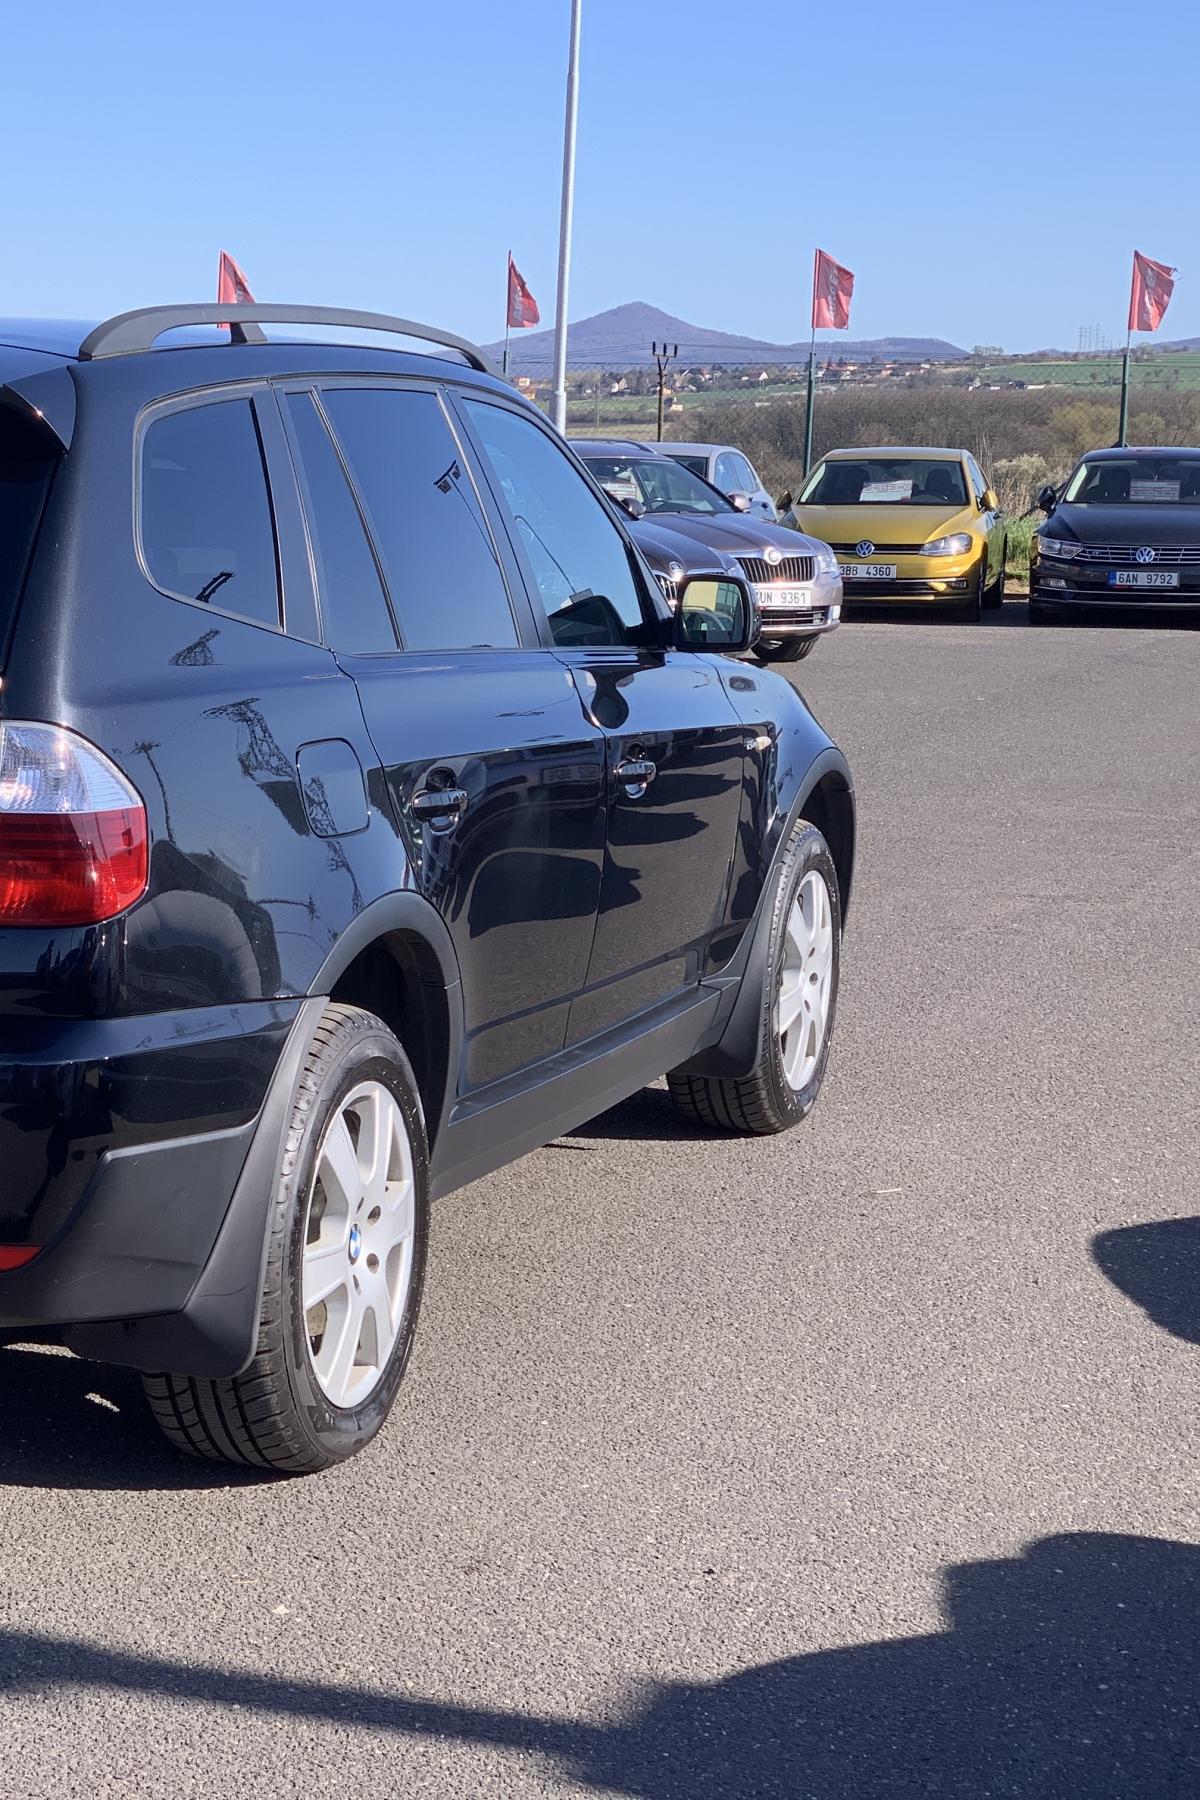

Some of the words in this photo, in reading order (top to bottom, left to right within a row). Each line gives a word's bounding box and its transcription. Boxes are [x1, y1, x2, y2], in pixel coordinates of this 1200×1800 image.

[865, 566, 891, 576] 4360
[1118, 573, 1139, 584] 6AN
[1146, 573, 1173, 584] 9792
[756, 591, 773, 604] UN
[780, 591, 806, 604] 9361
